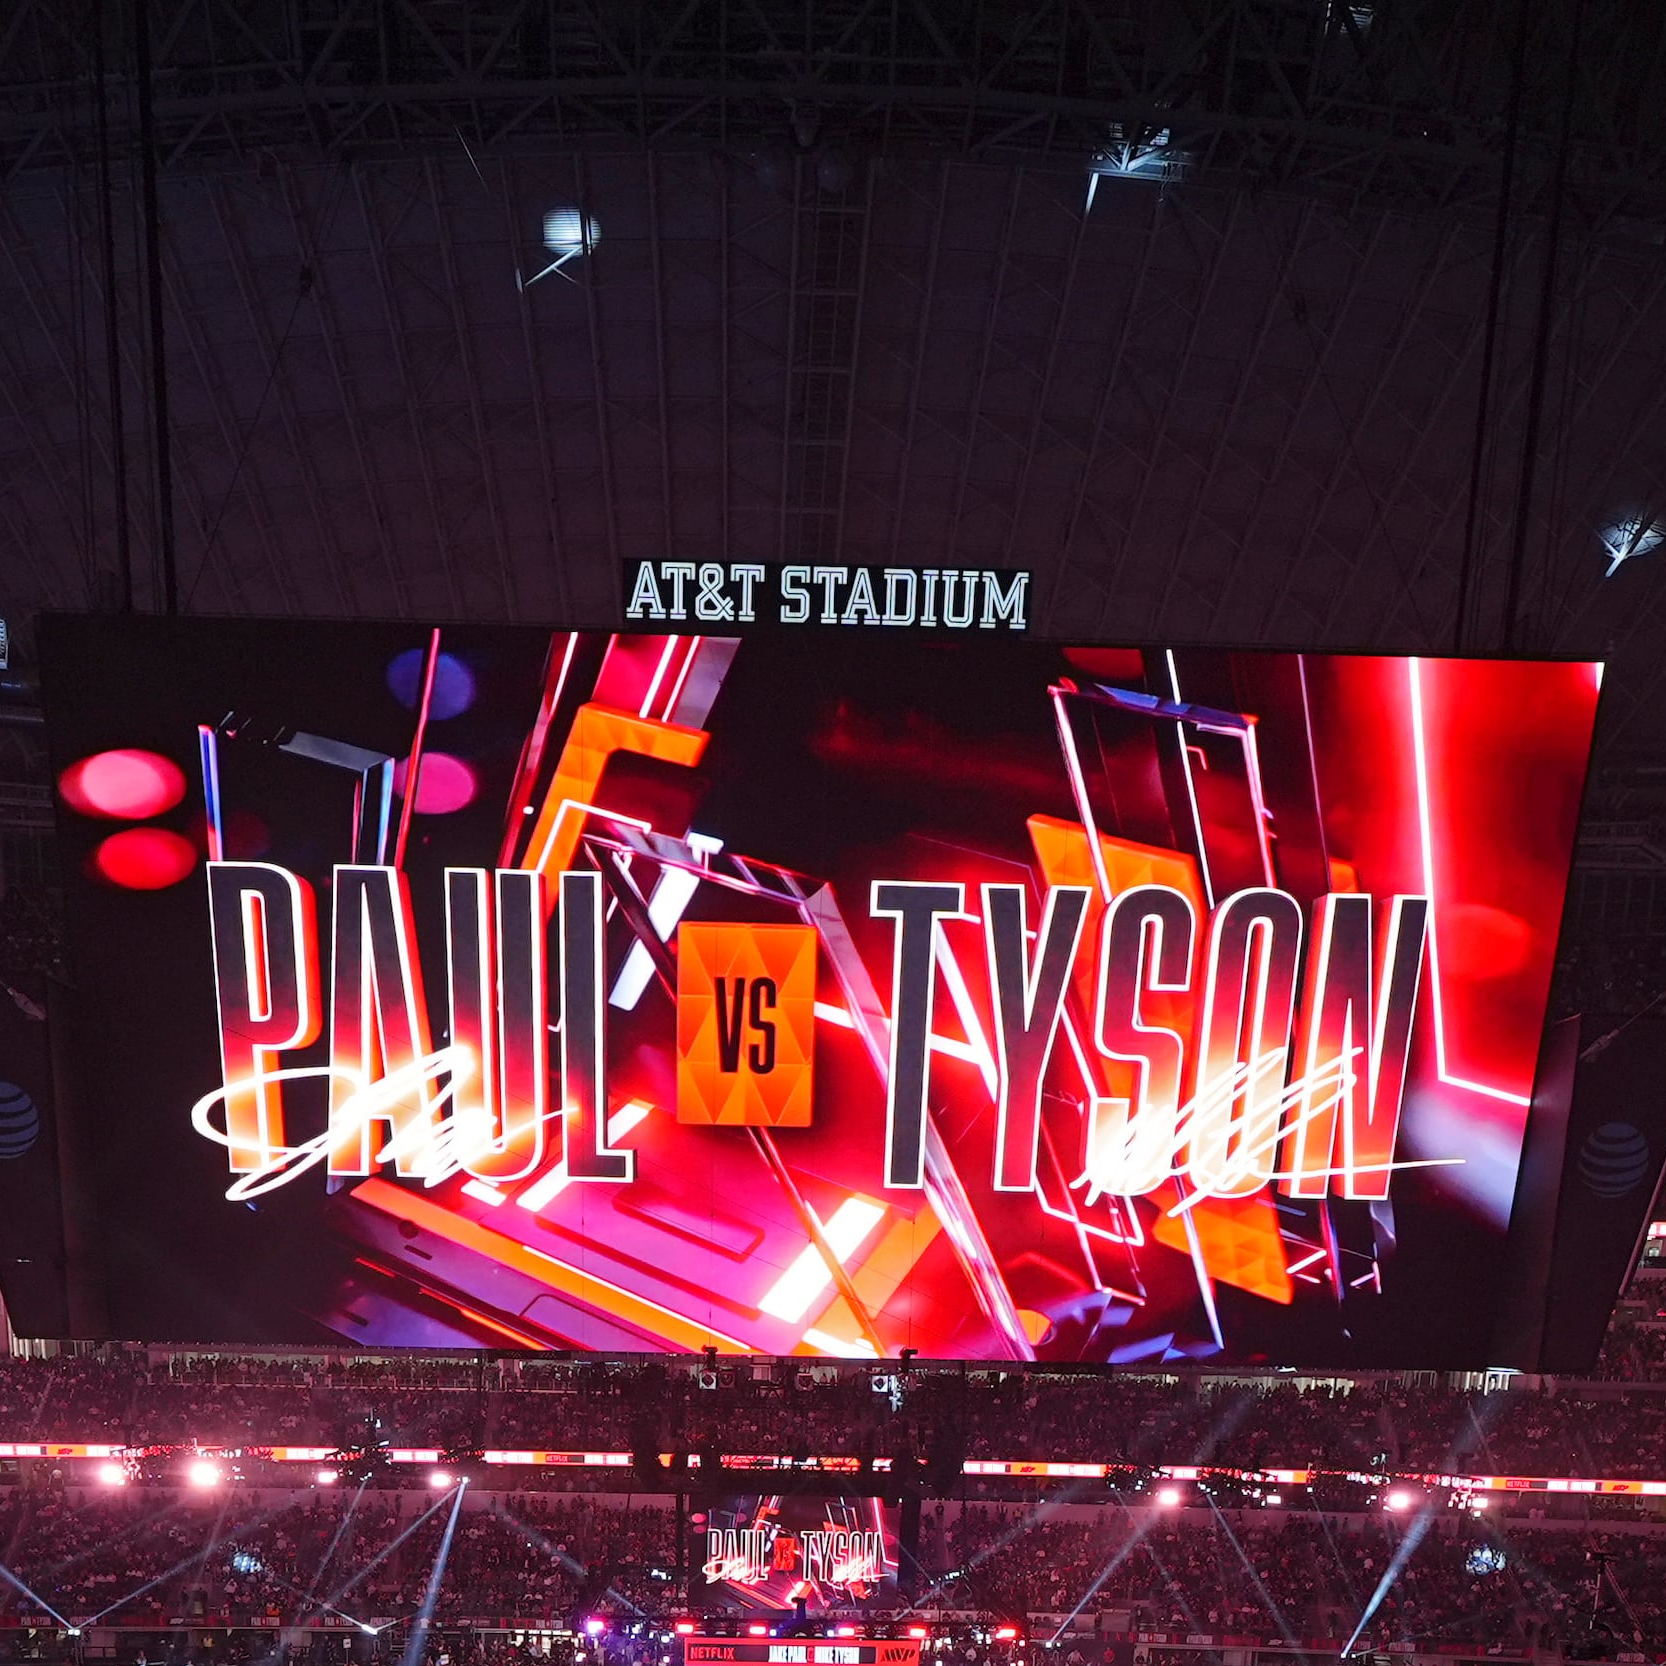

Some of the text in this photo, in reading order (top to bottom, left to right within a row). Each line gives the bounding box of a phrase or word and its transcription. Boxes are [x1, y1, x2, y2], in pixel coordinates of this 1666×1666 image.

[627, 561, 1029, 630] AT&T STADIUM
[206, 860, 1429, 1200] PAUL VS TYSON
[707, 1528, 882, 1583] PAUL TYSON
[691, 1648, 734, 1660] NETFLIX
